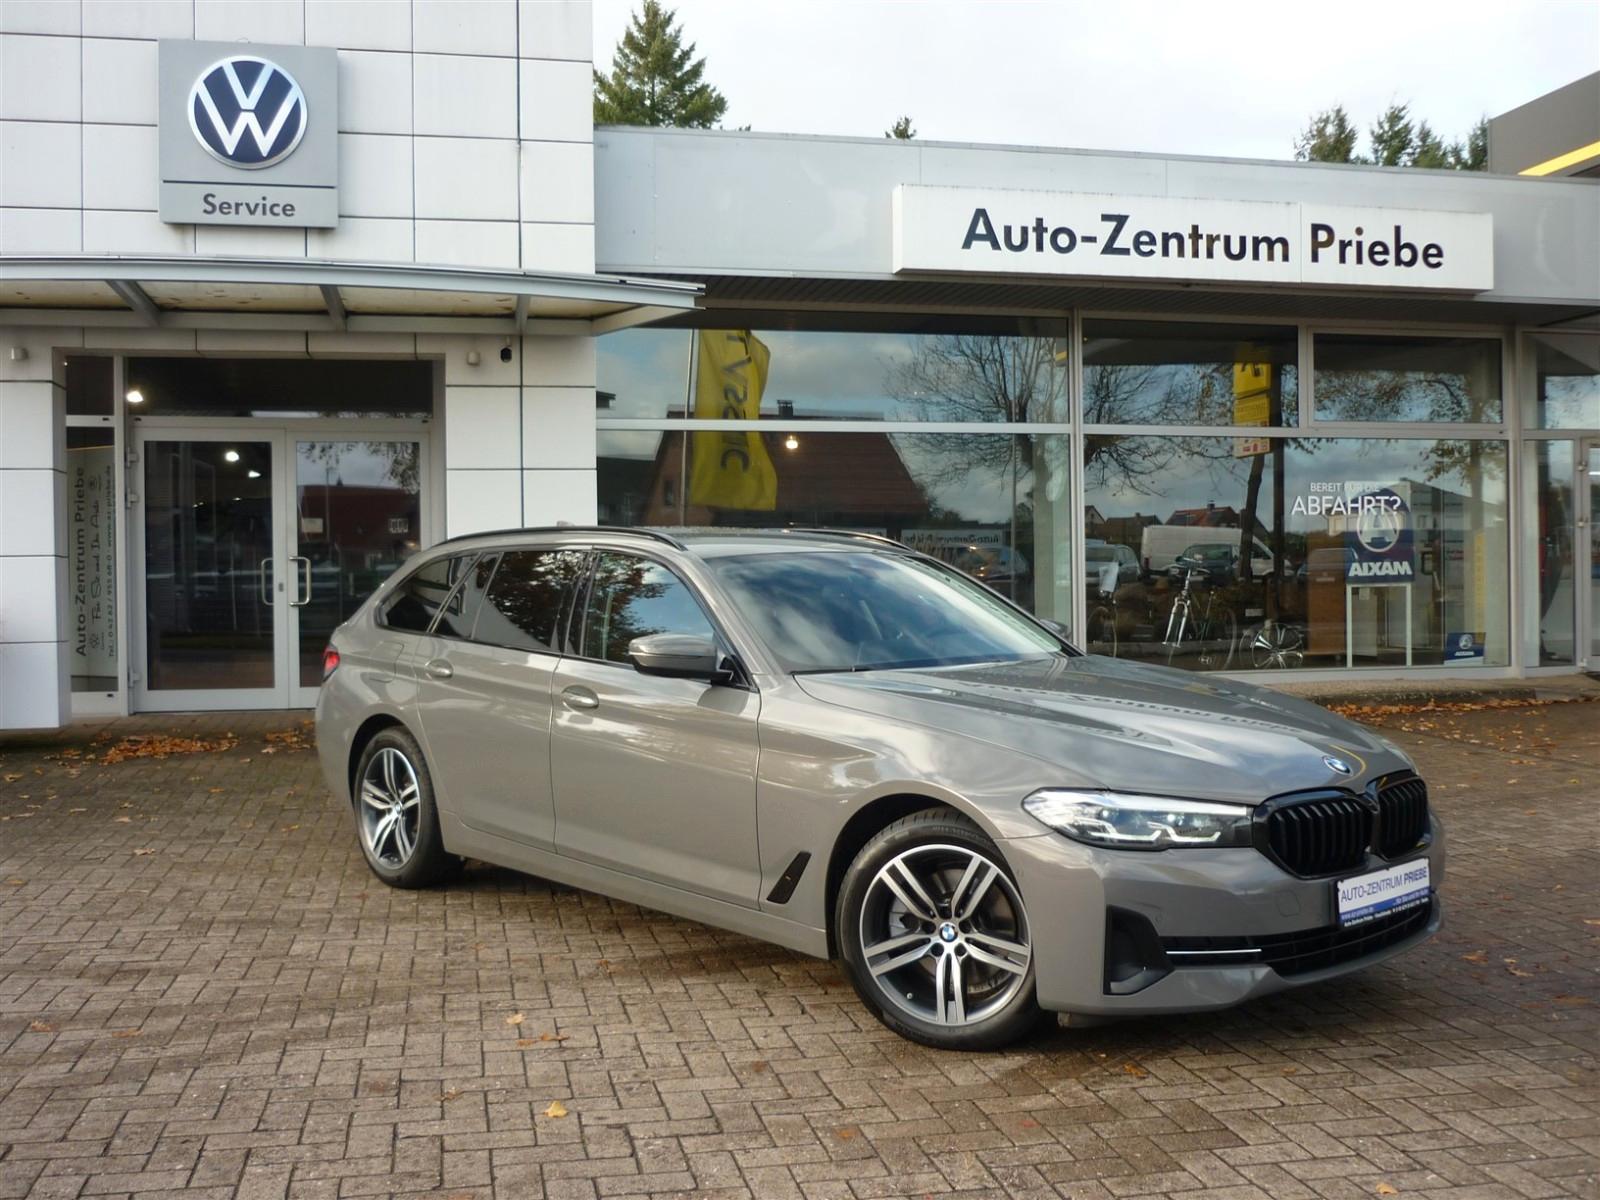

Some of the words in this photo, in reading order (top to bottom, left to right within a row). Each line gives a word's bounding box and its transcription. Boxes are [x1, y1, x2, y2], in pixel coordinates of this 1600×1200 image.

[202, 192, 296, 217] Service
[961, 207, 1291, 263] Auto-Zentrum
[1310, 222, 1445, 269] Priebe
[74, 466, 86, 523] Priebe
[1310, 482, 1342, 493] BEREIT
[1291, 495, 1401, 516] ABFAHRT?
[1348, 561, 1413, 577] AIXAM
[74, 528, 87, 657] Auto-Zentrum
[1341, 874, 1402, 902] AUTO-ZENTRUM
[1404, 867, 1427, 885] PRIEBE
